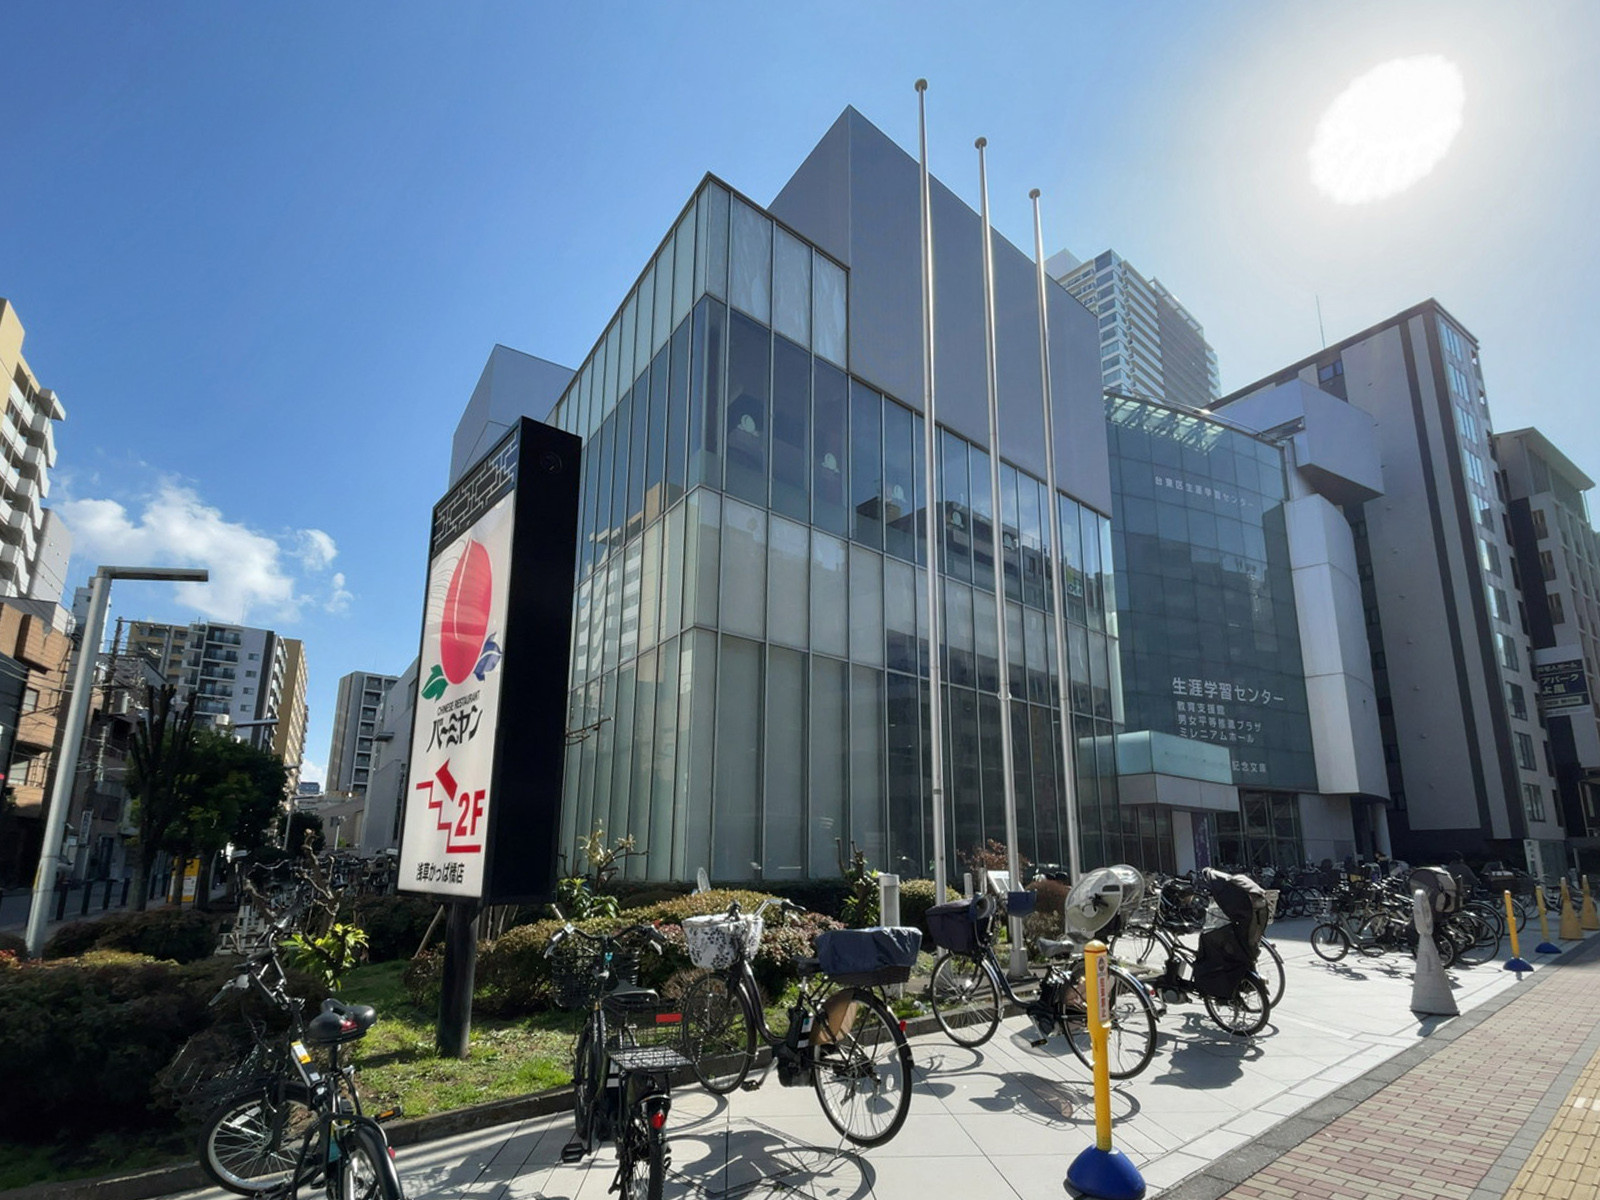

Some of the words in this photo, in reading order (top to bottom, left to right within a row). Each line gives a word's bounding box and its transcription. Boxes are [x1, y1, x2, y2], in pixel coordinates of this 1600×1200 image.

[1172, 677, 1284, 705] 生涯学習センター
[437, 701, 454, 716] CHINESE
[426, 705, 483, 753] バーミヤン
[1180, 727, 1255, 743] ミレニアムホール
[454, 789, 486, 837] 2F
[416, 862, 465, 884] 浅草かっぱ橋店
